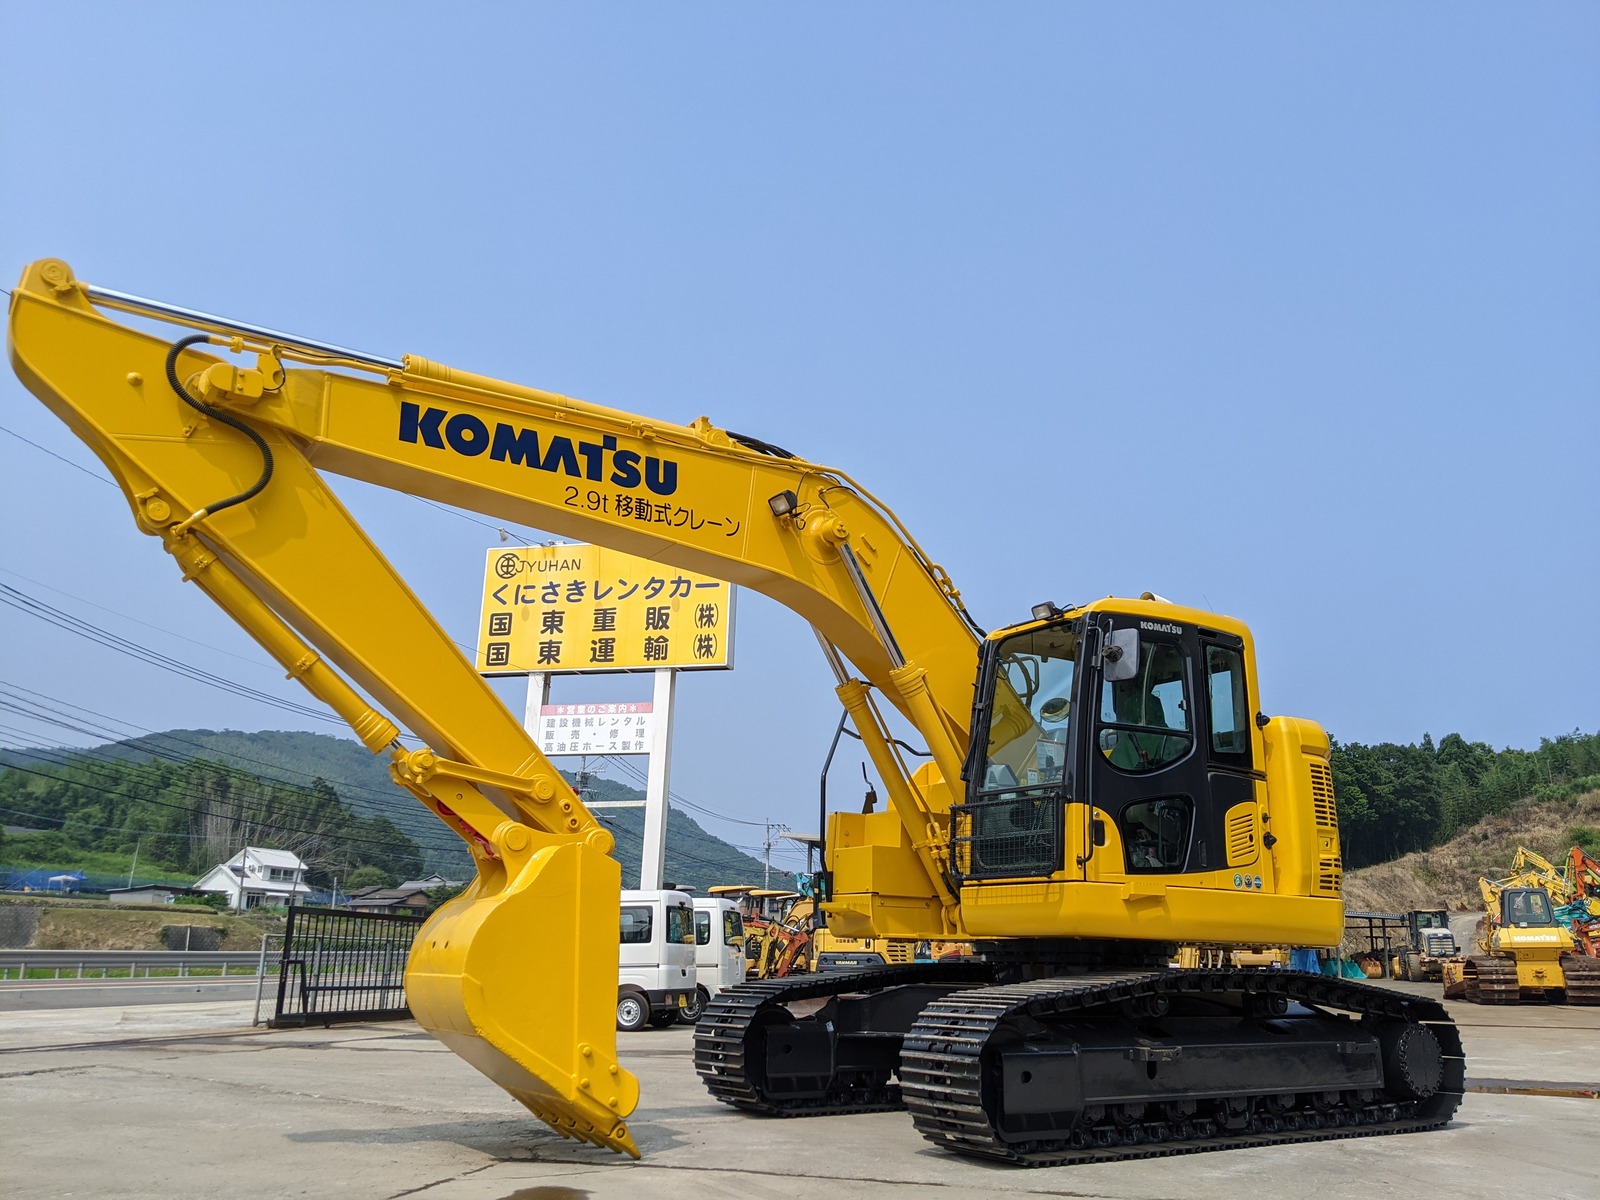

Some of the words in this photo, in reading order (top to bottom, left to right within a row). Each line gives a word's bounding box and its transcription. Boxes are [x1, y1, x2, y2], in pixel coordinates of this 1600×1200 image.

[399, 401, 678, 495] KOMATSU
[565, 486, 609, 514] 2.9t
[615, 493, 740, 537] 移動式クレーン
[515, 558, 581, 573] JYUHAN
[493, 576, 720, 605] くにさきレンタカー
[1140, 621, 1182, 634] KOMATSU
[546, 716, 646, 728] 建設機械レンタル
[544, 740, 644, 752] 高油圧ホース製作
[1513, 934, 1557, 942] KOMATSU
